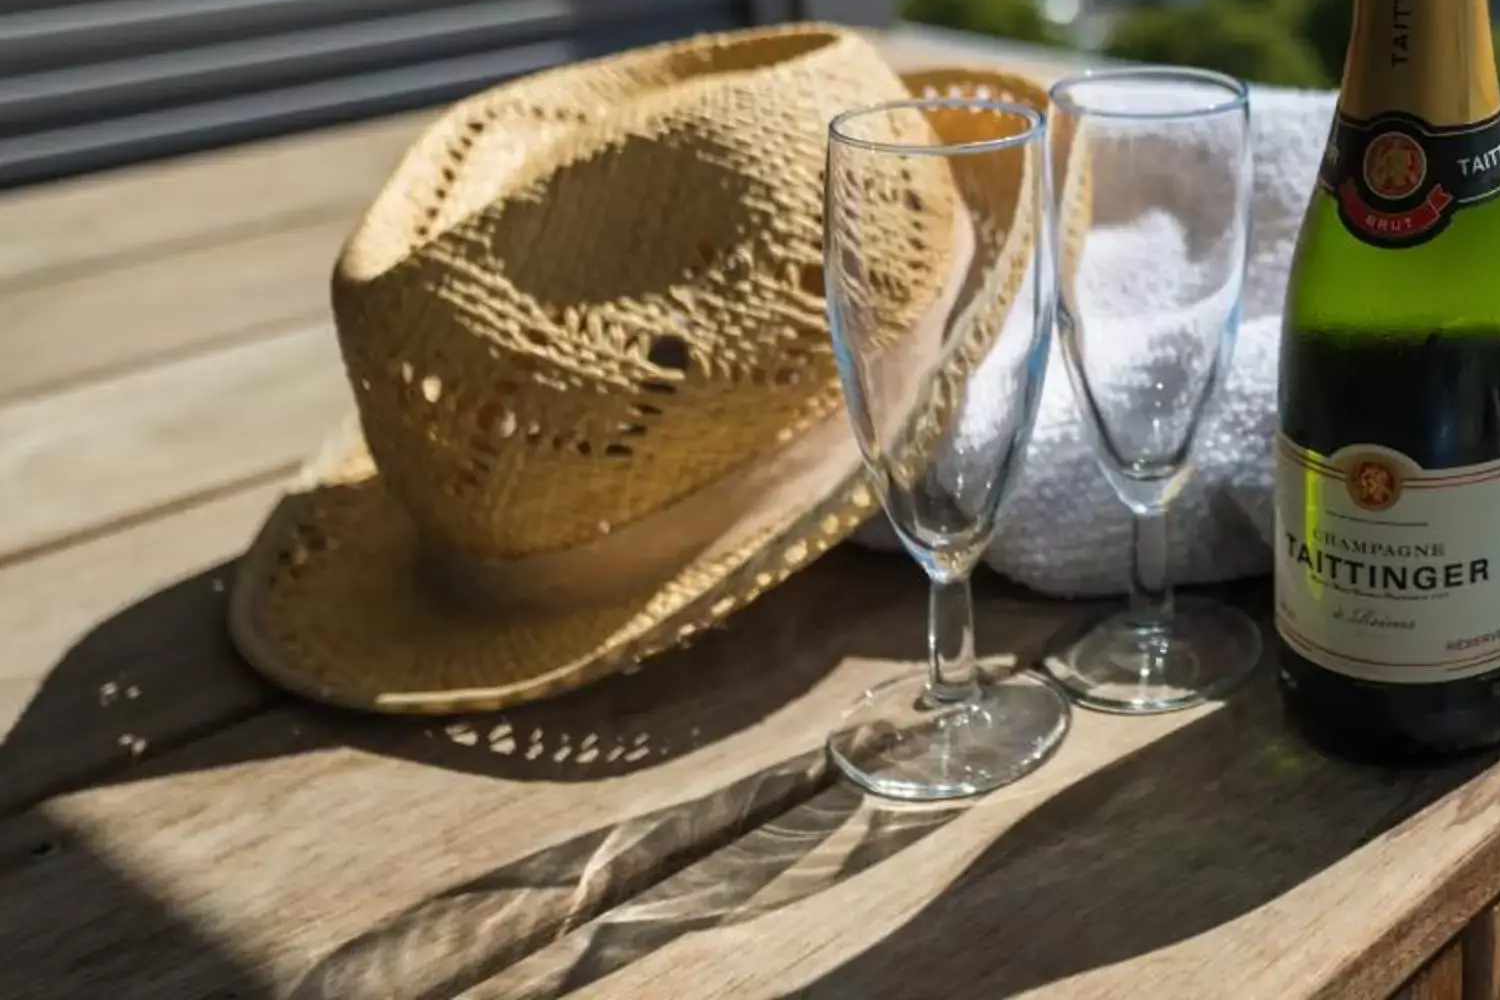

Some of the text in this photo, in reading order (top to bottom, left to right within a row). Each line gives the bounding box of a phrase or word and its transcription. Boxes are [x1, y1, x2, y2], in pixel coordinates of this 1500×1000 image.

[1364, 214, 1412, 231] BRUT
[1312, 528, 1446, 559] CHAMPAGNE
[1286, 532, 1490, 591] TAITTINGER
